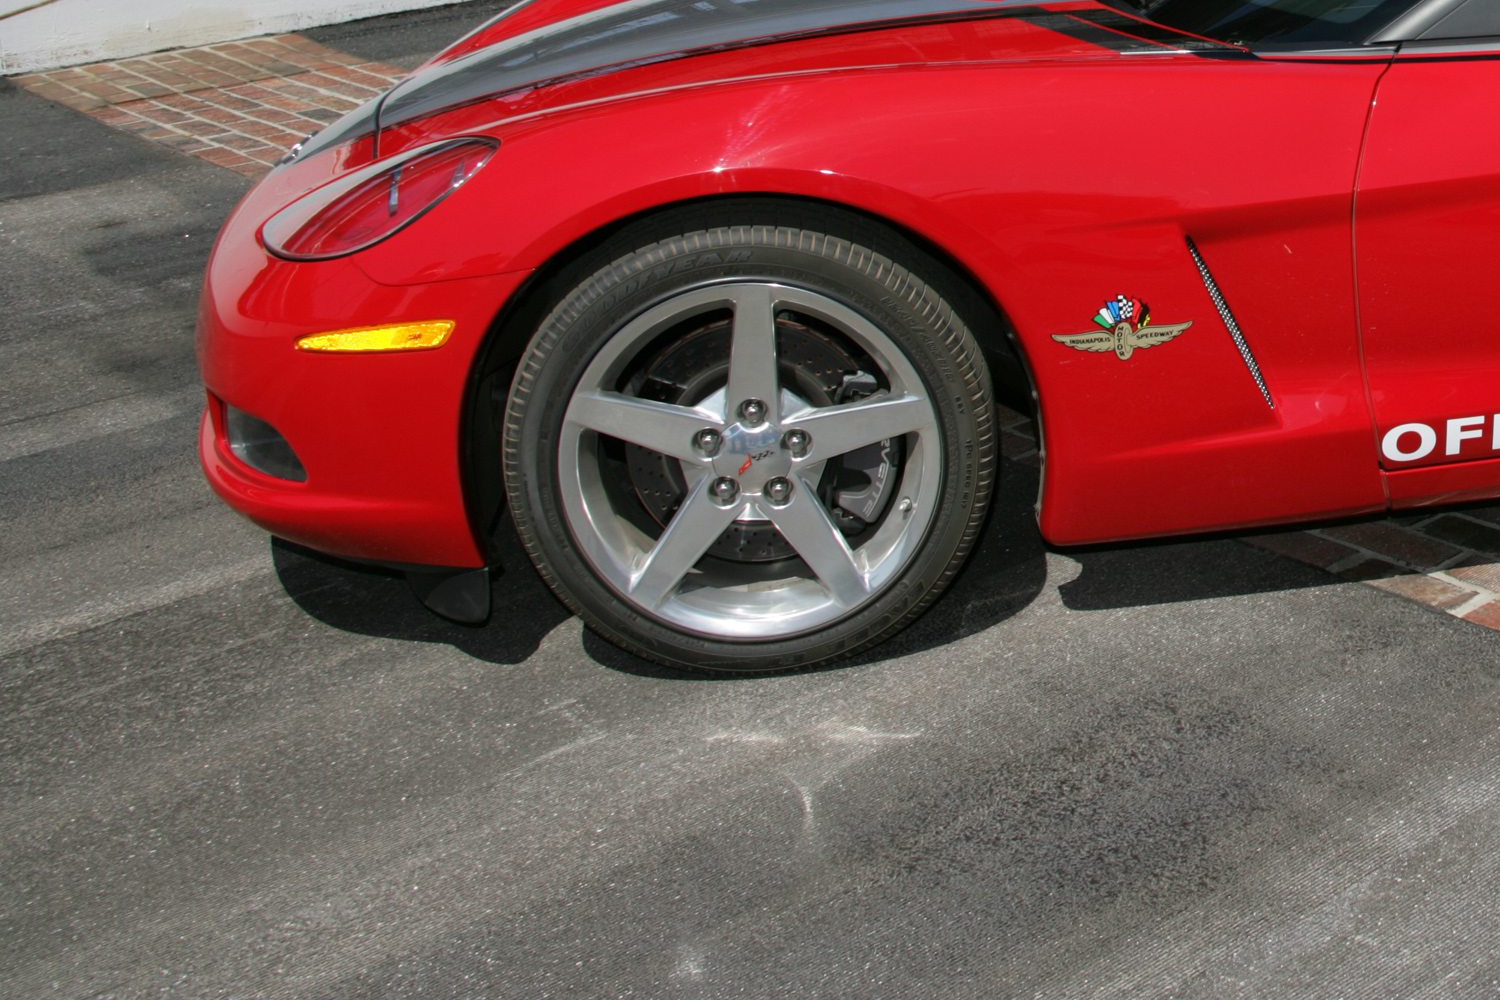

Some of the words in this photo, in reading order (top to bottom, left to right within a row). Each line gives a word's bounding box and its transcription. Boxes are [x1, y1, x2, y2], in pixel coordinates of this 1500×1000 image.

[1136, 330, 1174, 340] SPEEDWAY
[1069, 337, 1111, 345] INDIANAPOLIS
[1116, 326, 1125, 357] MOTOR
